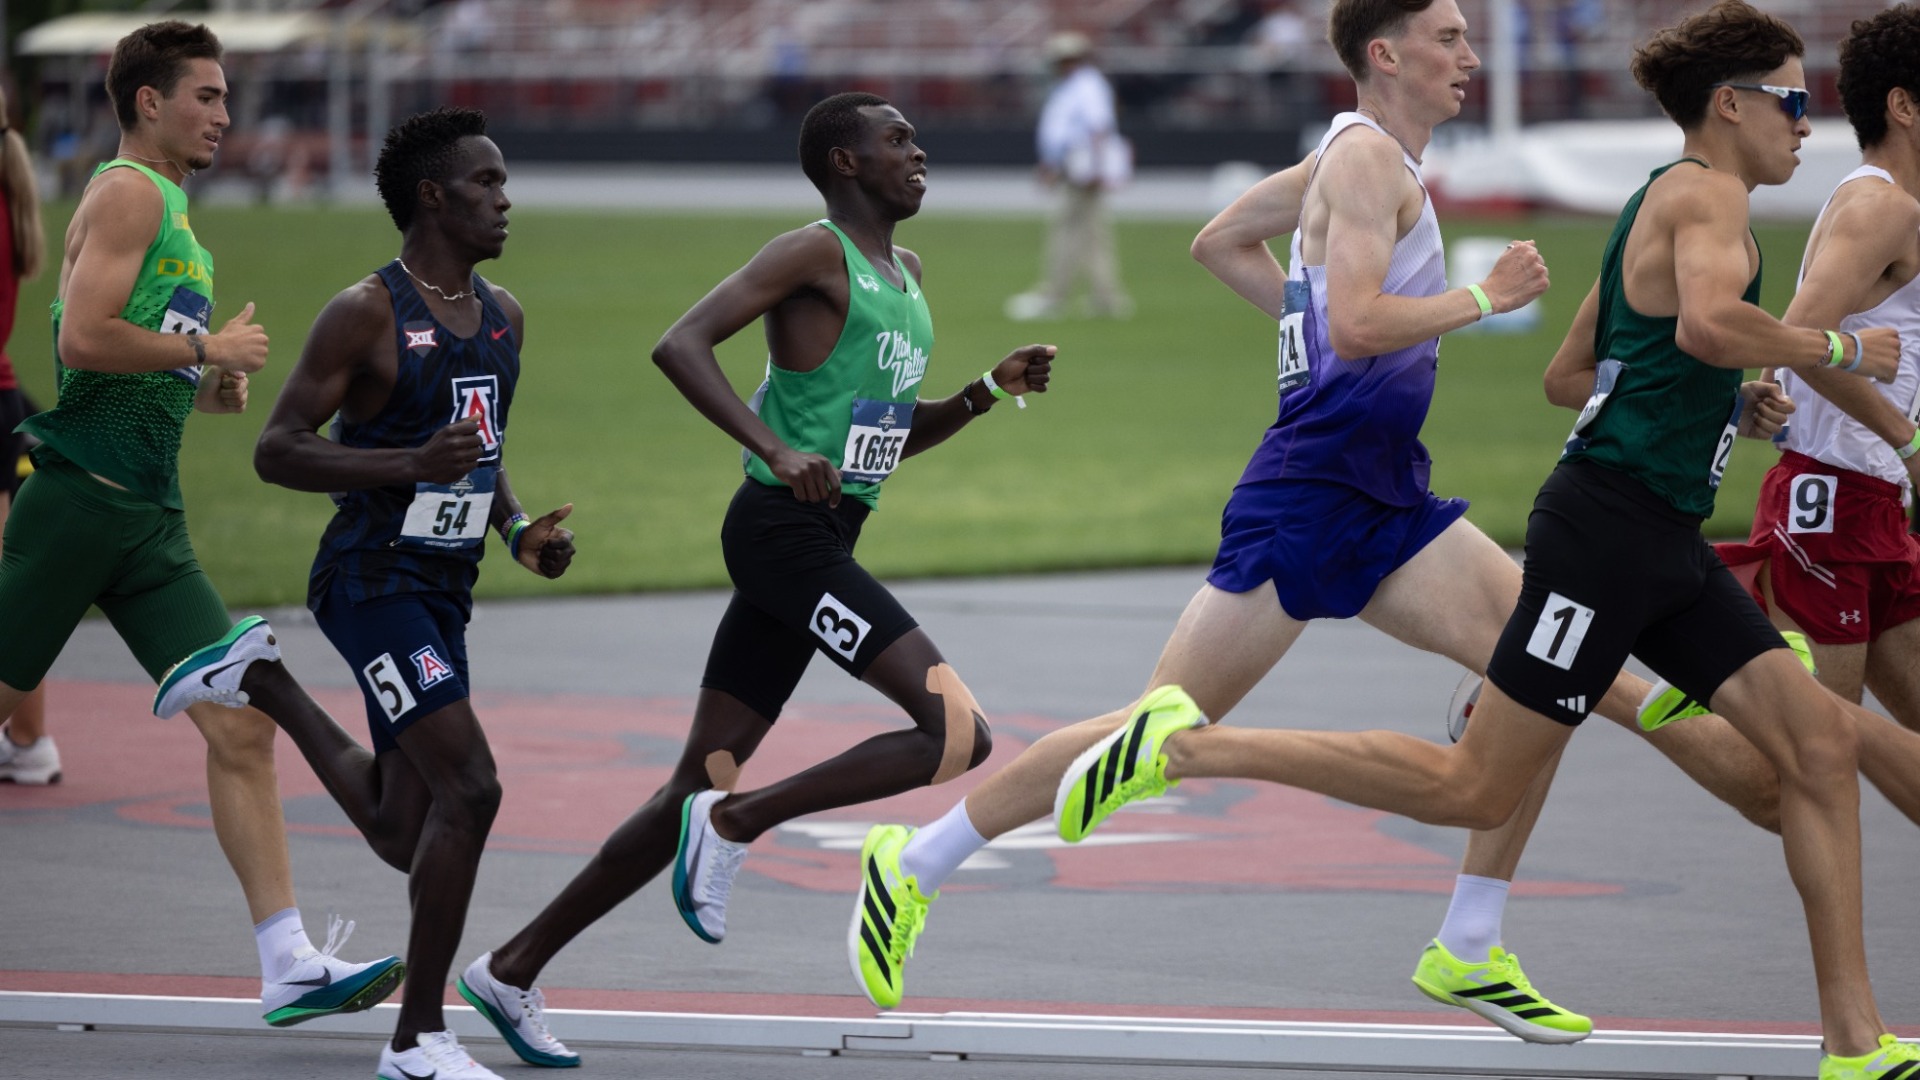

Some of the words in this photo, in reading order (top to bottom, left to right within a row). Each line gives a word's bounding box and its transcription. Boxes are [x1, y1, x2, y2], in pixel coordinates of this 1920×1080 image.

[450, 375, 503, 462] A
[850, 433, 904, 472] 1655
[1715, 432, 1733, 473] 2
[432, 500, 472, 536] 54
[1795, 478, 1830, 529] 9
[816, 606, 859, 652] 3
[1546, 605, 1577, 661] 1
[368, 661, 403, 717] 5
[409, 645, 454, 691] A
